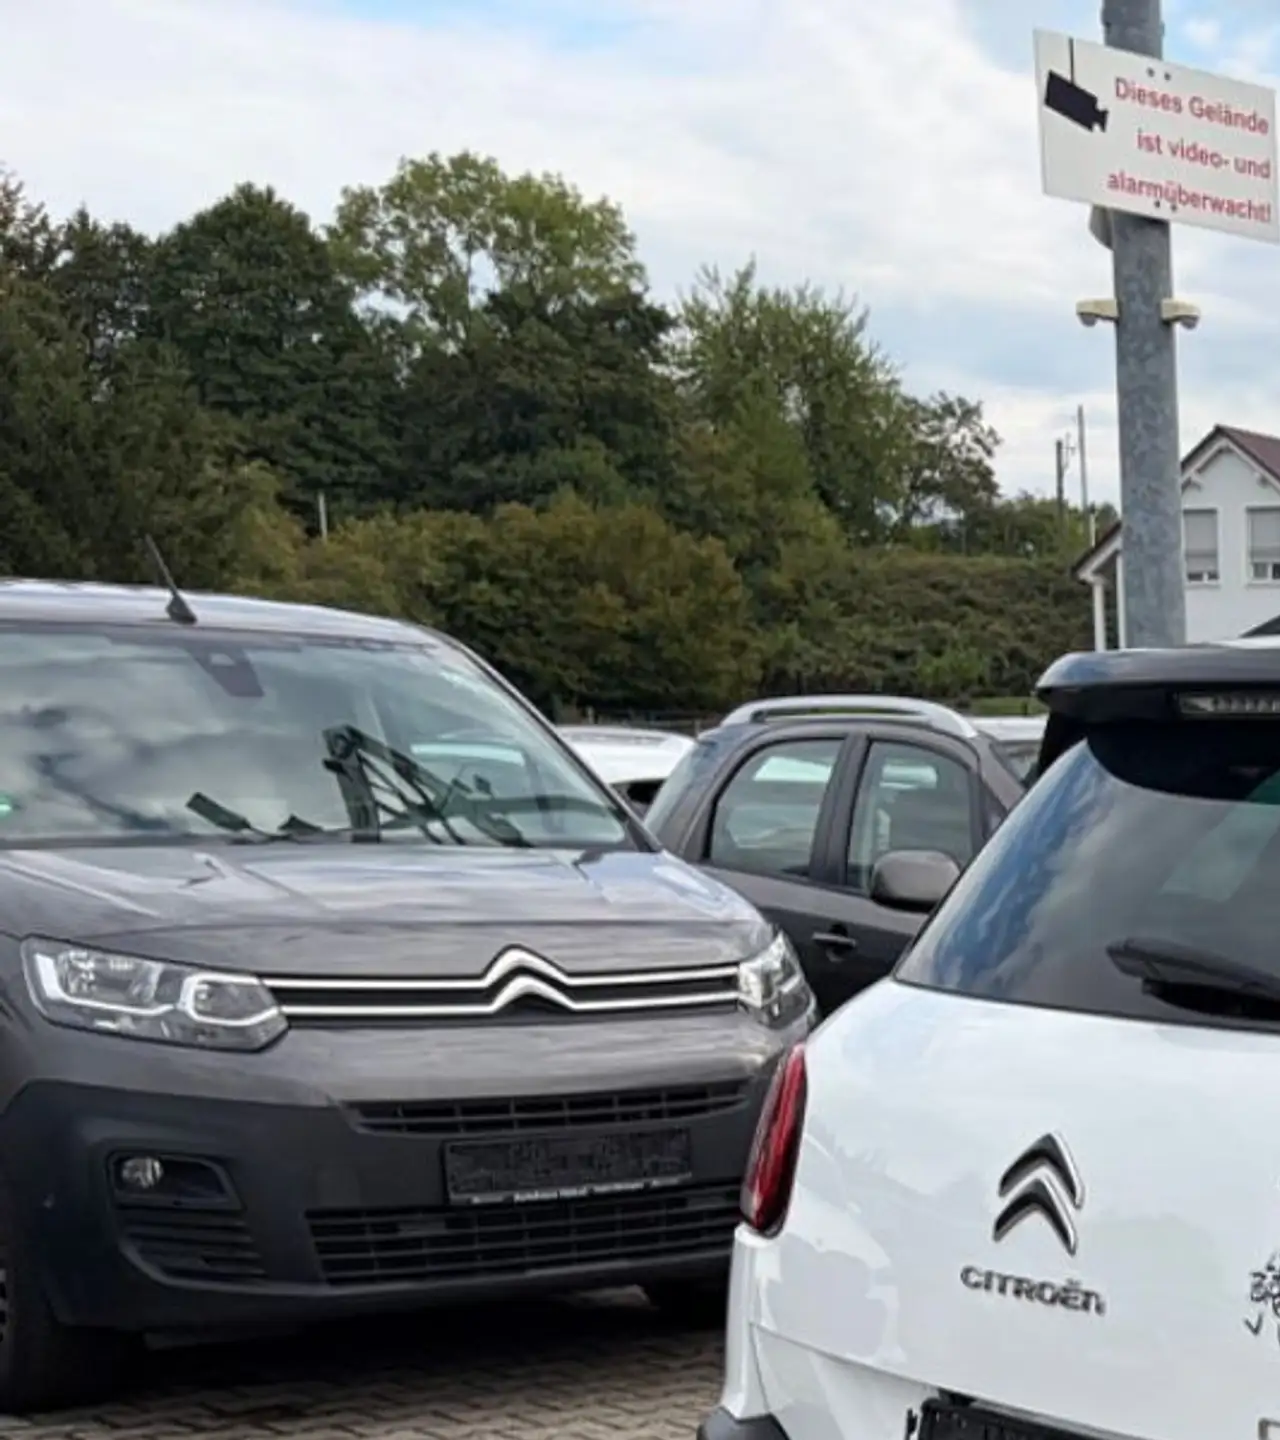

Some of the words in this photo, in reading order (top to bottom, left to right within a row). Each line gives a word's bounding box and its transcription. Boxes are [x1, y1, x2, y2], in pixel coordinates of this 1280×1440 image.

[1114, 77, 1183, 113] Dieses
[1189, 96, 1269, 134] Gelände
[1137, 128, 1163, 155] ist
[1168, 138, 1229, 168] video-
[1234, 158, 1271, 179] und
[1107, 171, 1271, 222] alarmüberwacht!
